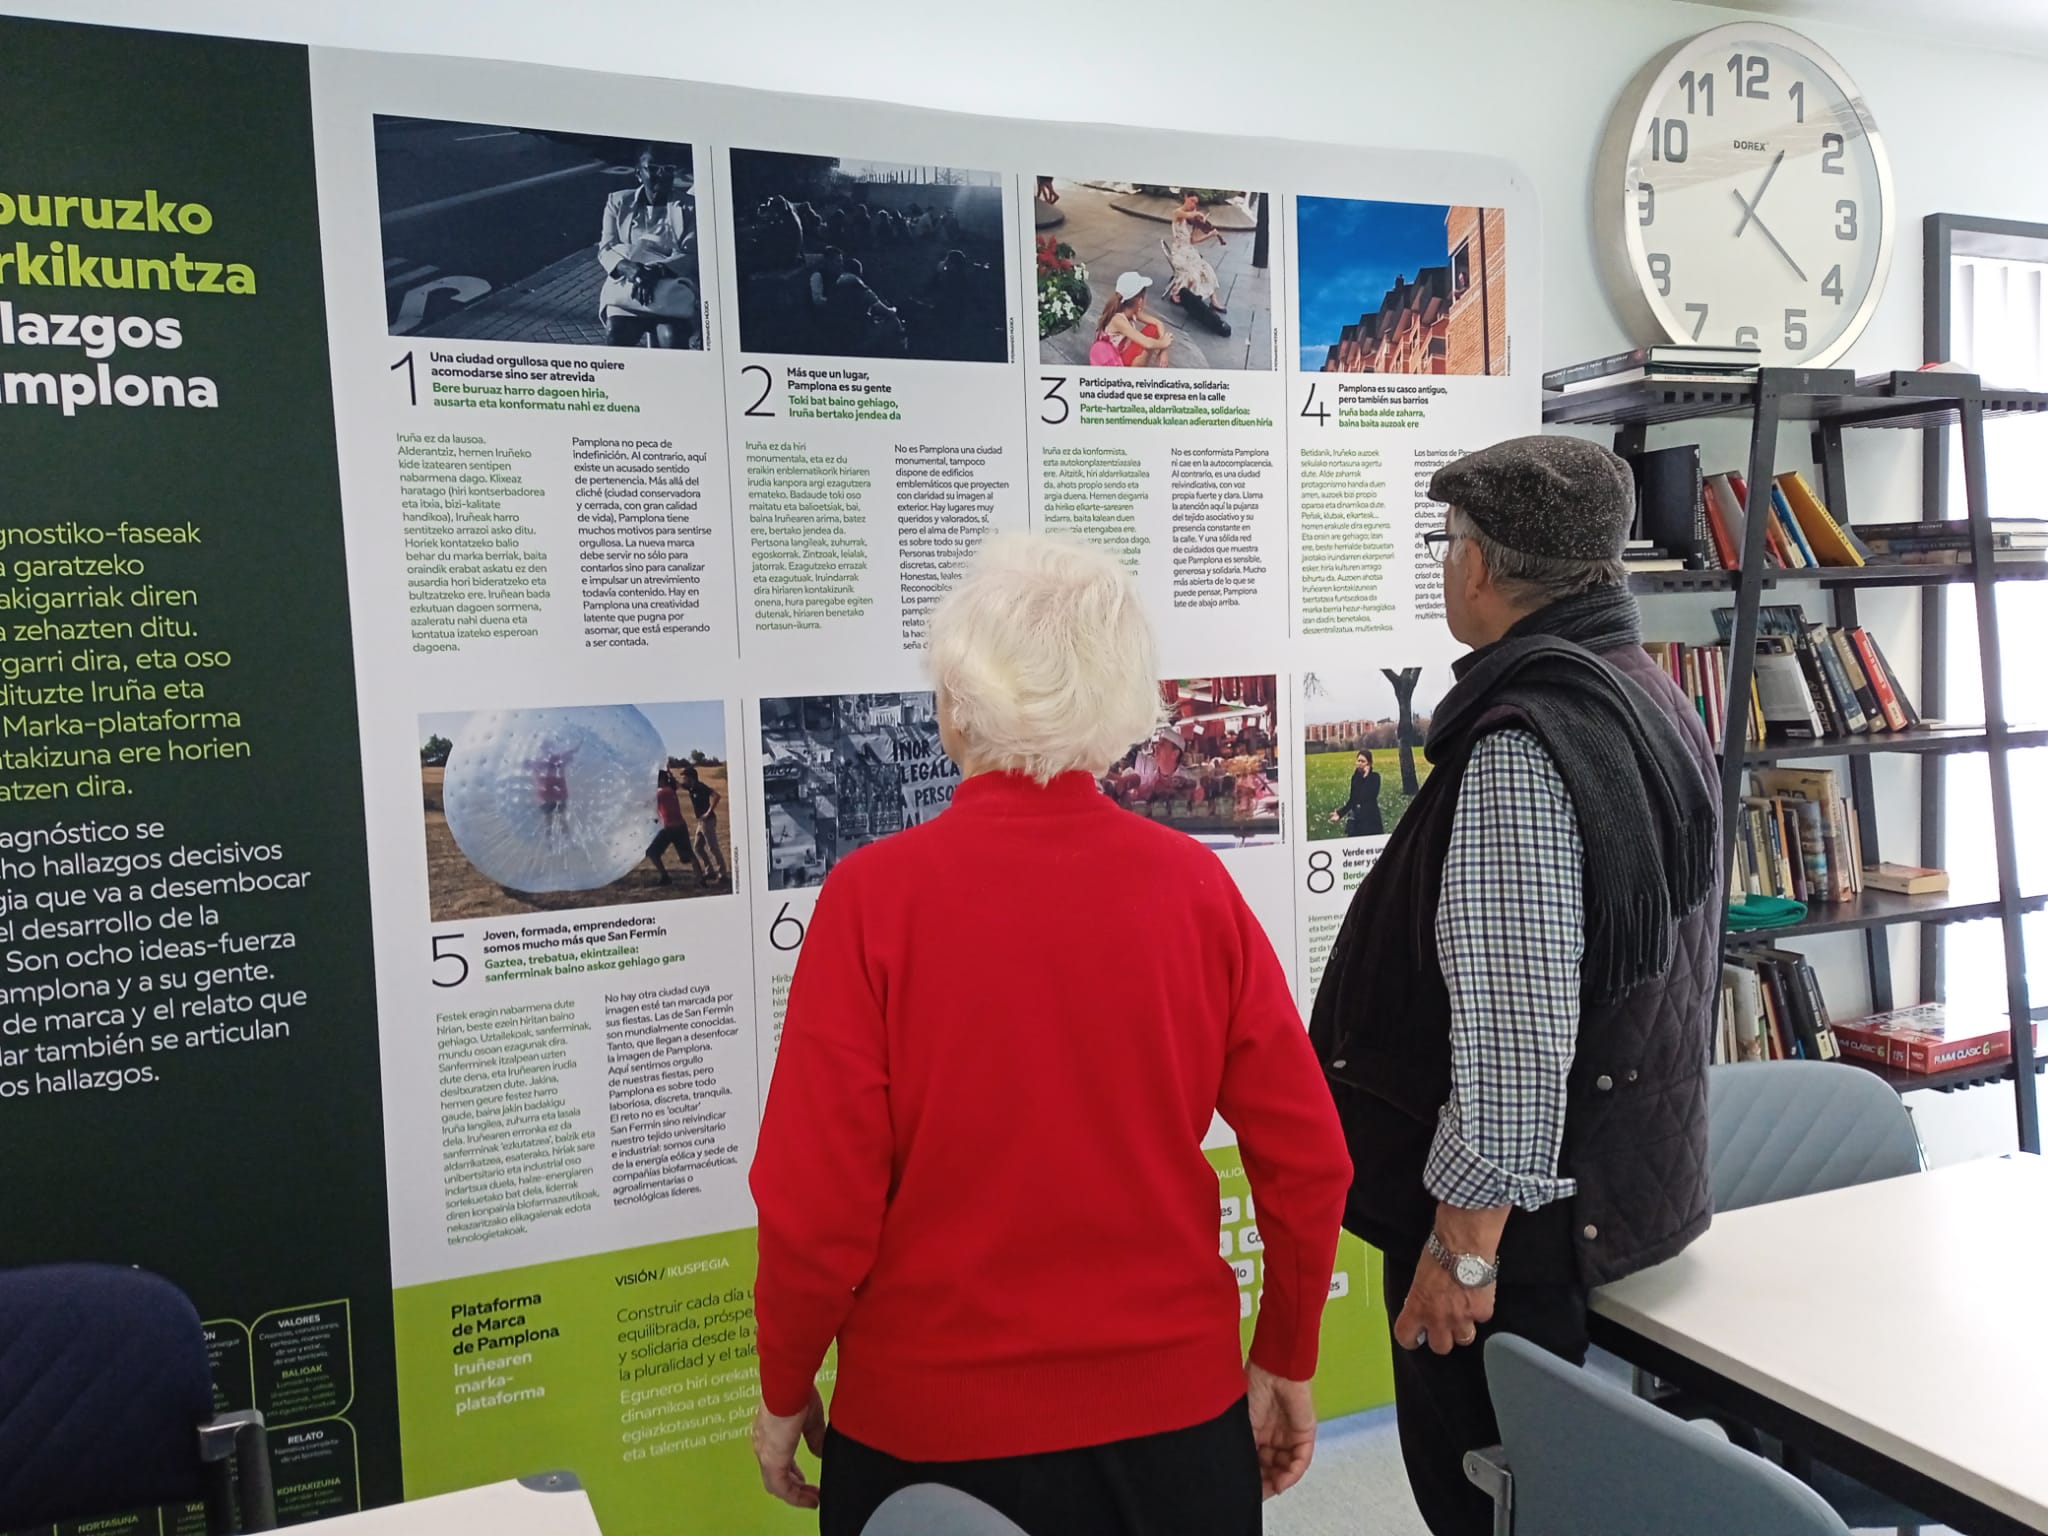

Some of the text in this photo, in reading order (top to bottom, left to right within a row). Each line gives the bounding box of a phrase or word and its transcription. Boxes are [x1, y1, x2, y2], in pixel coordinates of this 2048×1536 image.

[1726, 53, 1769, 100] 12
[1679, 70, 1714, 117] 11
[1788, 81, 1804, 123] 1
[1648, 116, 1688, 163] 10
[1733, 140, 1766, 152] DOREX
[1822, 132, 1844, 175] 2
[1835, 199, 1858, 241] 3
[1647, 253, 1671, 297] 8
[1821, 264, 1844, 305] 4
[0, 301, 183, 358] lazgos
[1685, 303, 1708, 342] 7
[1784, 308, 1807, 350] 5
[430, 351, 625, 371] Una ciudad orgullosa que no quiere
[787, 367, 807, 377] Más
[808, 370, 827, 380] que
[842, 369, 869, 381] lugar,
[390, 351, 416, 406] 1
[431, 368, 595, 382] acomodarse sino ser atrevida
[787, 380, 837, 392] Pamplona
[851, 384, 862, 392] su
[863, 384, 891, 394] gente
[1079, 377, 1230, 390] Participativa, reivindicativa, solidaria:
[3, 363, 219, 416] mplona
[432, 382, 608, 399] Bere buruaz harro dagoen hiria,
[741, 365, 776, 417] 2
[788, 395, 898, 409] Toki bat baino gehiago,
[1040, 376, 1069, 424] 3
[1096, 389, 1125, 399] ciudad
[1126, 392, 1142, 401] que
[1154, 393, 1186, 401] expresa
[1198, 392, 1206, 401] la
[1207, 392, 1226, 401] calle
[1338, 383, 1376, 394] Pamplona
[1417, 385, 1447, 395] antiguo,
[1338, 396, 1357, 405] pero
[1357, 395, 1389, 404] también
[1402, 396, 1429, 404] barrios
[433, 398, 640, 412] ausarta eta konformatu nahi ez duena
[789, 407, 901, 421] Iruña bertako jendea da
[1300, 383, 1331, 427] 4
[13, 555, 144, 582] garatzeko
[0, 585, 197, 614] akigarriak diren
[13, 616, 197, 641] zehazten ditu.
[71, 649, 128, 671] dira,
[136, 649, 177, 669] eta
[184, 651, 231, 667] oso
[3, 709, 241, 737] Marka-plataforma
[118, 738, 250, 763] ere horien
[43, 844, 282, 876] hallazgos decisivos
[1342, 848, 1364, 857] Verde
[1307, 850, 1335, 894] 8
[35, 872, 311, 911] que va a desembocar
[482, 917, 656, 941] Joven, formada, emprendedora:
[483, 926, 667, 953] somos mucho más que San Fermín
[769, 902, 804, 951] 6
[6, 933, 295, 972] Son ocho ideas-fuerza
[431, 933, 469, 988] 5
[484, 946, 639, 969] Gaztea, trebatua, ekintzailea:
[1957, 1045, 1982, 1060] CLASIC
[1982, 1041, 1990, 1056] 6
[35, 1066, 159, 1092] hallazgos.
[615, 1257, 729, 1286] VISIÓN / IKUSPEGIA
[451, 1294, 541, 1318] Plataforma
[616, 1288, 744, 1322] Construir cada día
[277, 1313, 321, 1328] VALORES
[452, 1315, 525, 1337] de Marca
[617, 1317, 700, 1342] equilibrada,
[452, 1327, 560, 1355] de Pamplona
[281, 1364, 323, 1379] BALIOAK
[454, 1353, 532, 1376] Iruñearen
[455, 1376, 513, 1394] marka-
[456, 1387, 545, 1415] plataforma
[288, 1431, 324, 1445] RELATO
